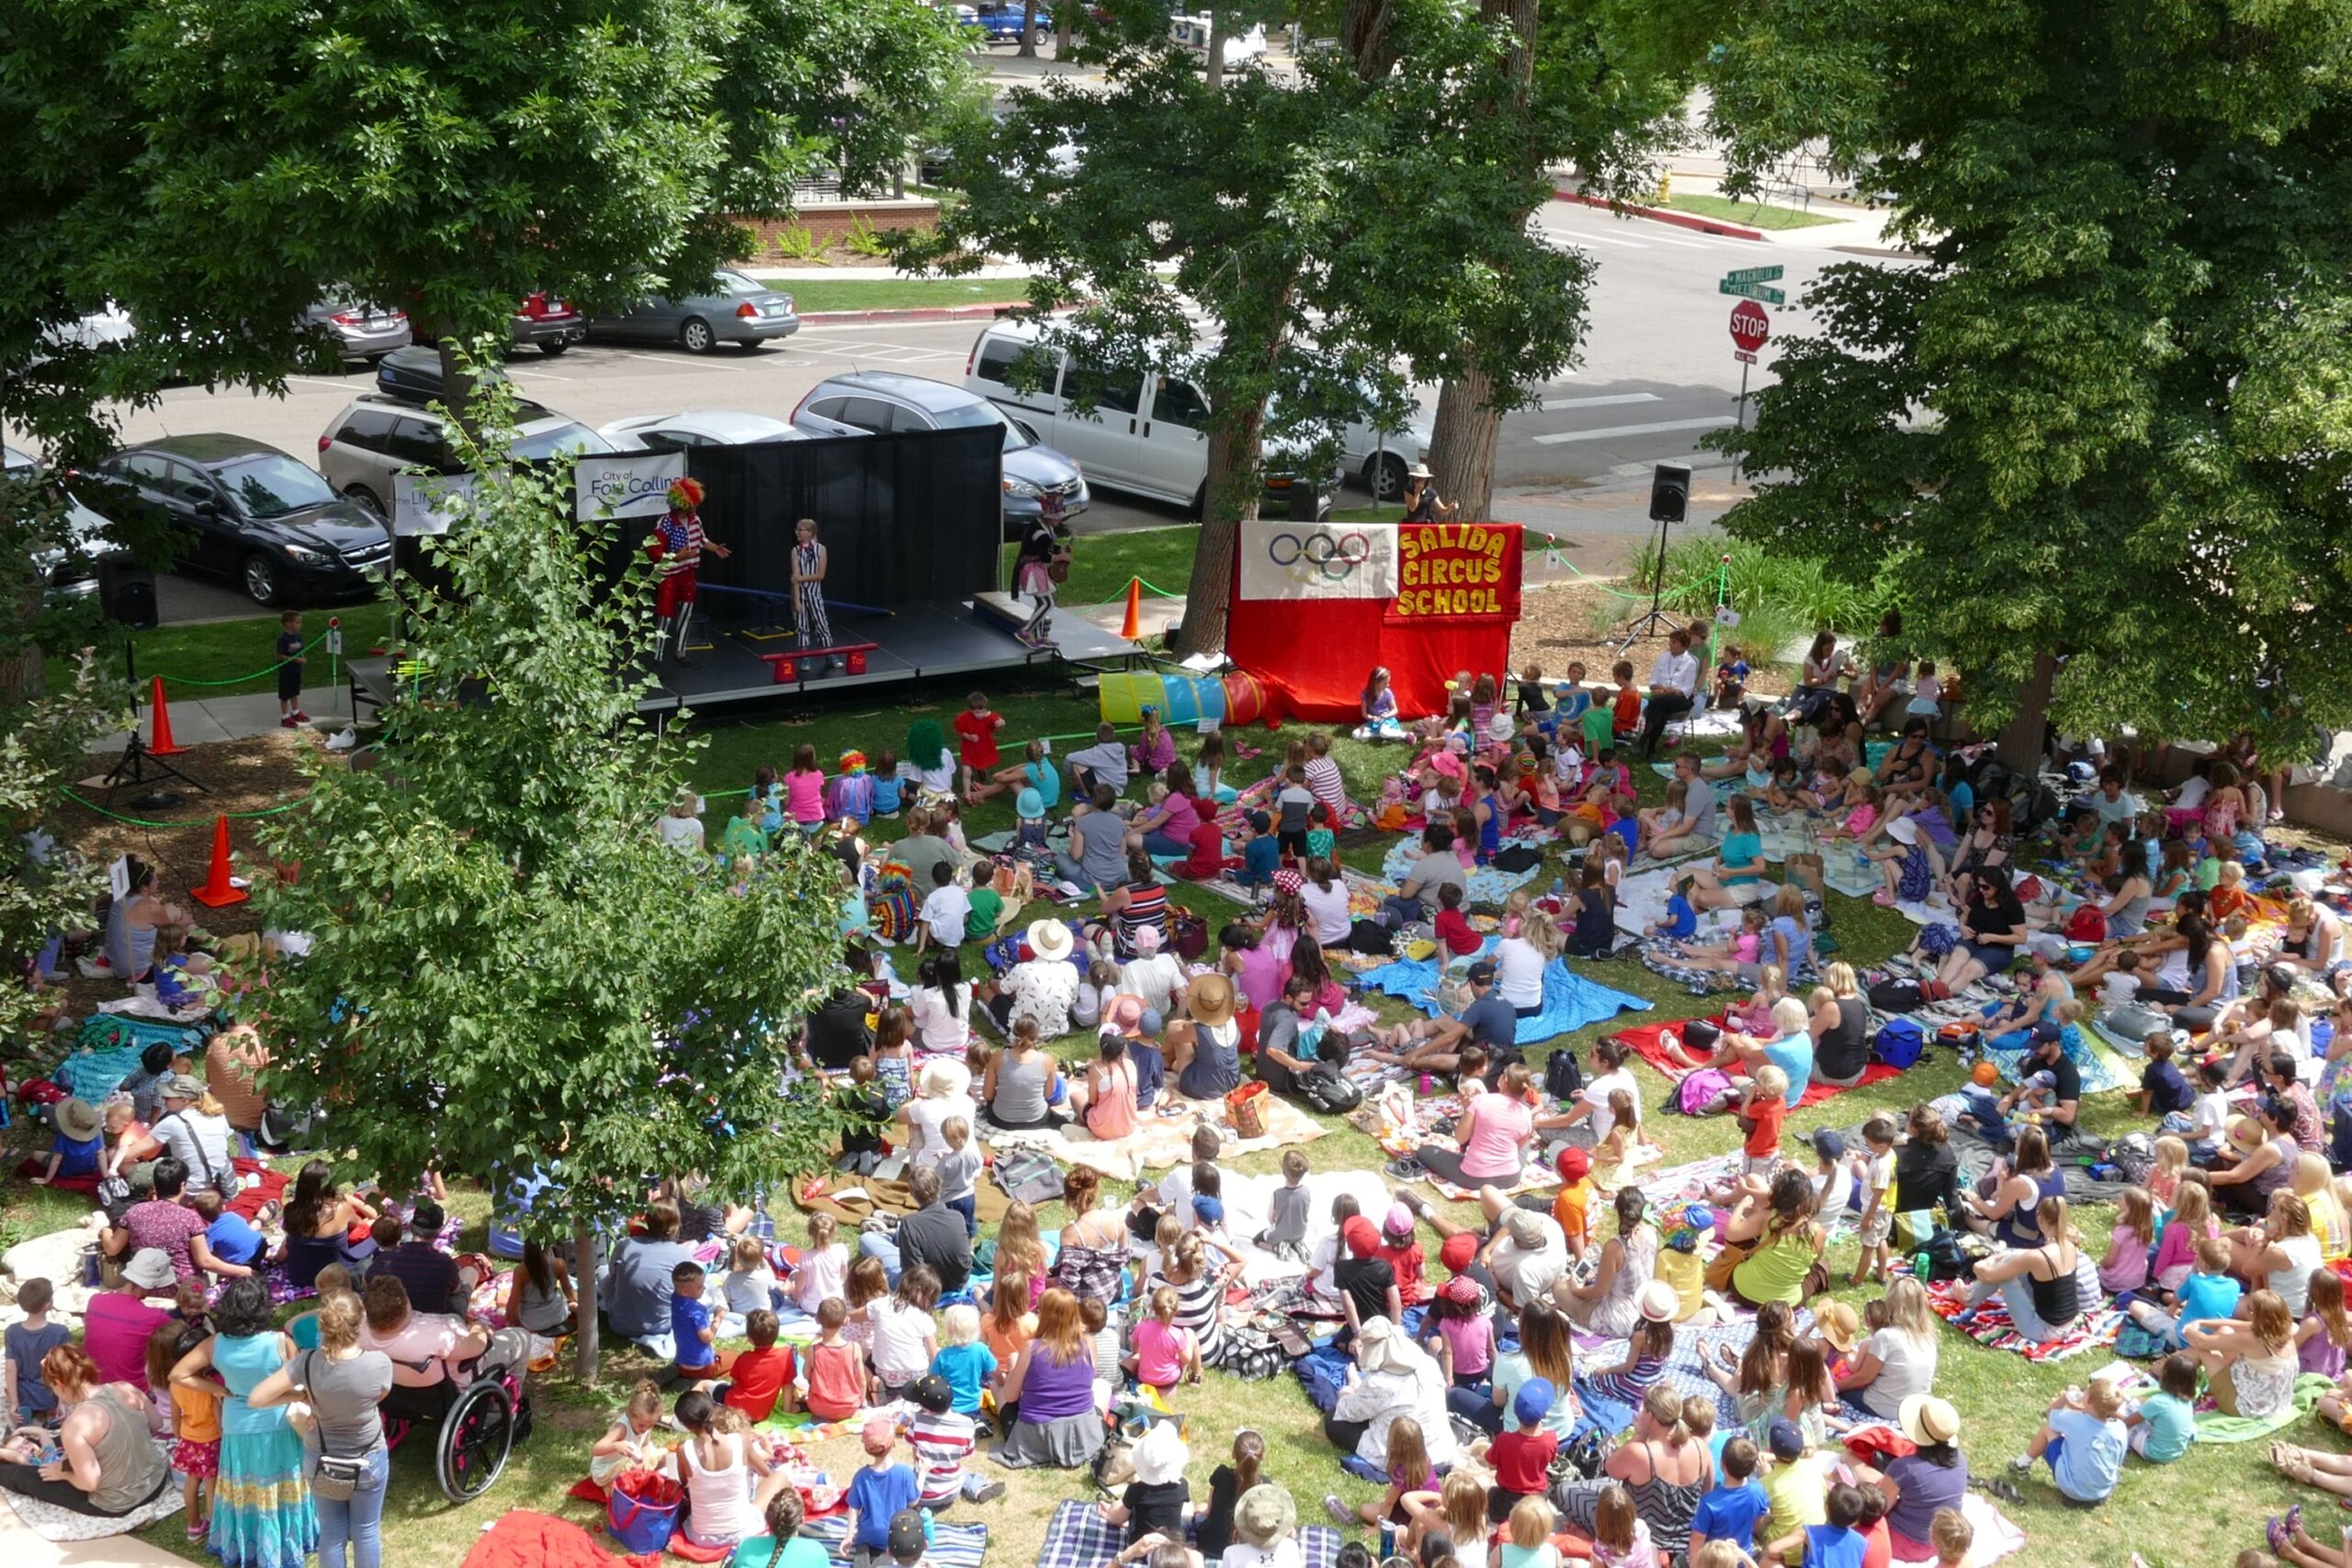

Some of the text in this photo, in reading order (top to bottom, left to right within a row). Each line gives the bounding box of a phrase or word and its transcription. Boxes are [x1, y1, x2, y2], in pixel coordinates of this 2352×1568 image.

[1735, 267, 1772, 284] MAGNOLIA
[1731, 313, 1767, 338] STOP
[602, 469, 633, 480] City of
[1398, 524, 1506, 558] SALIDA
[1403, 558, 1501, 586] CIRCUS
[1396, 588, 1502, 615] SCHOOL
[784, 663, 792, 674] 2
